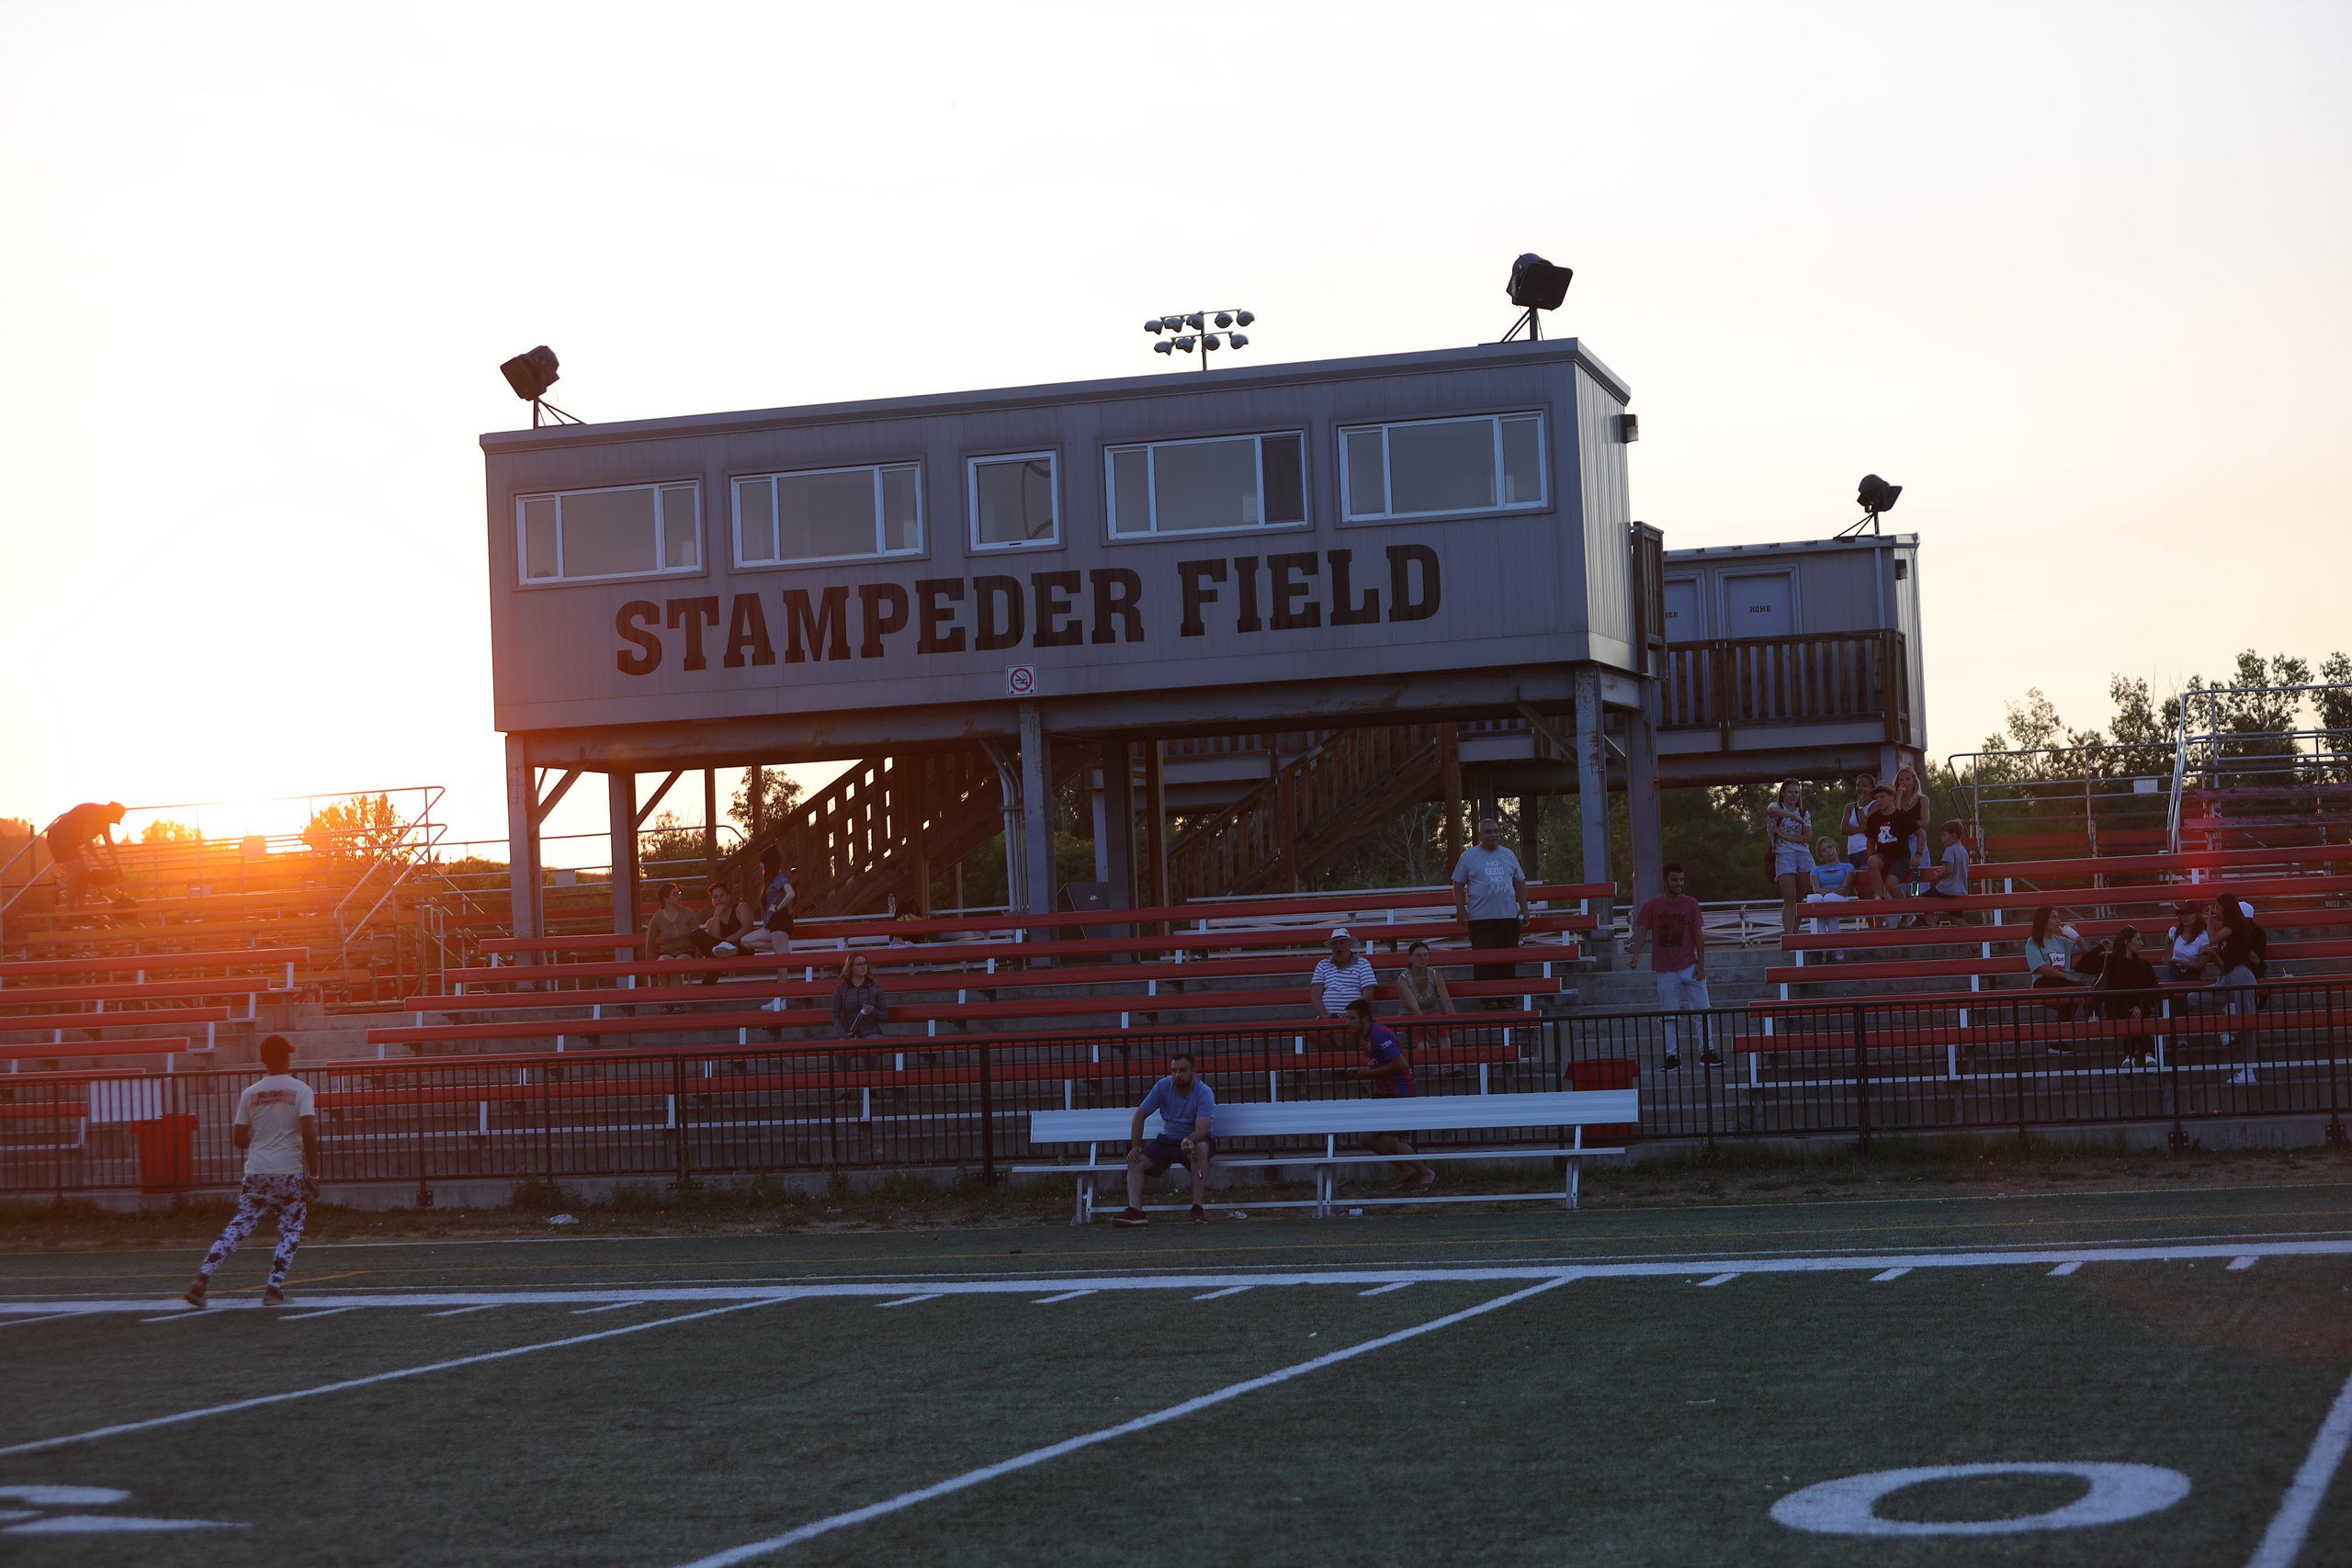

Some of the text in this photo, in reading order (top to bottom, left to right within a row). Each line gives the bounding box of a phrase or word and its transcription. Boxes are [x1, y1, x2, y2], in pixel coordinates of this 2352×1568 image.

[616, 544, 1441, 676] STAMPEDER FIELD
[1749, 604, 1771, 613] HOME
